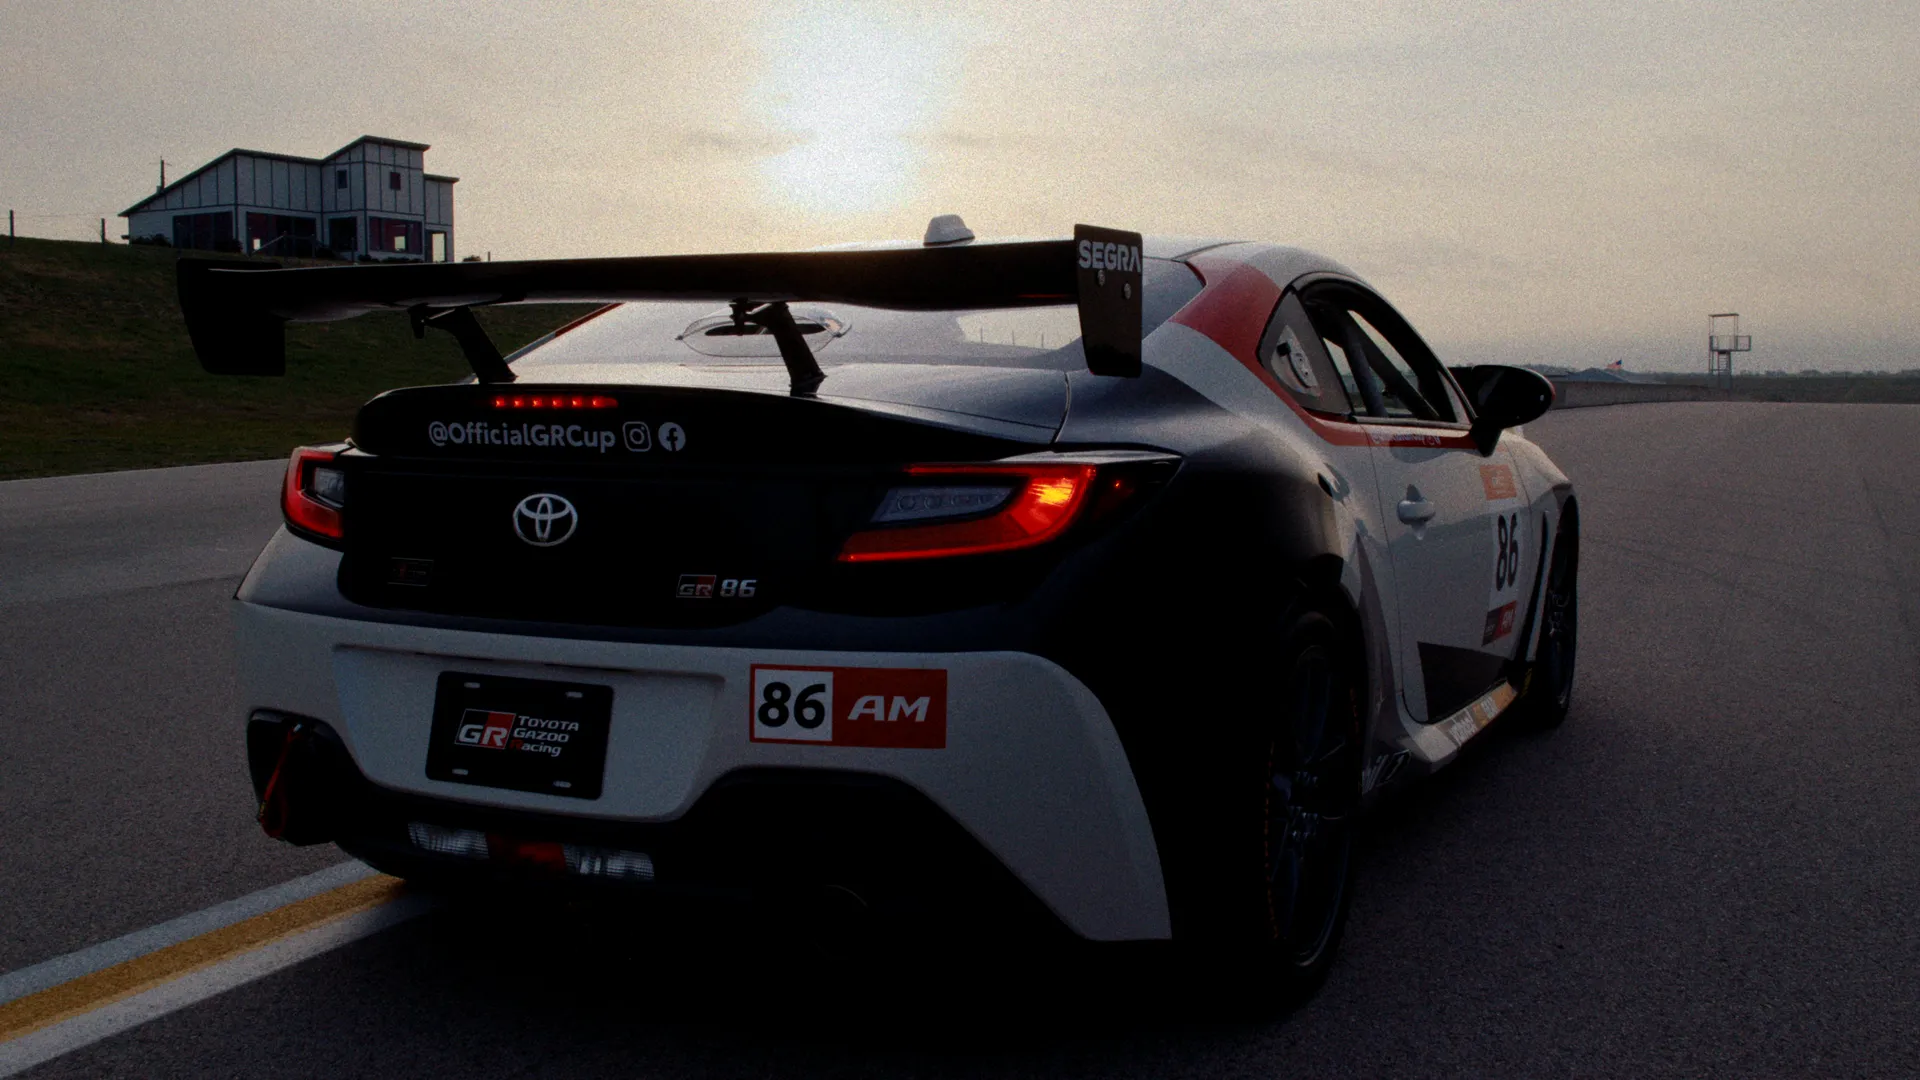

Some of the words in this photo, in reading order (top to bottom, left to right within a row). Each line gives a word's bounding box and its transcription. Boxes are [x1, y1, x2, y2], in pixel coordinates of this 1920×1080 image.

[1079, 239, 1141, 272] SEGRA
[428, 420, 616, 453] @OfficialGRCup
[1496, 513, 1519, 591] 86
[679, 582, 713, 598] GR
[720, 578, 758, 598] 86
[758, 681, 827, 729] 86
[847, 695, 931, 723] AM
[459, 724, 509, 748] GR
[512, 726, 570, 744] GAZOO
[517, 715, 580, 733] TOYOTA
[510, 737, 562, 758] Racing
